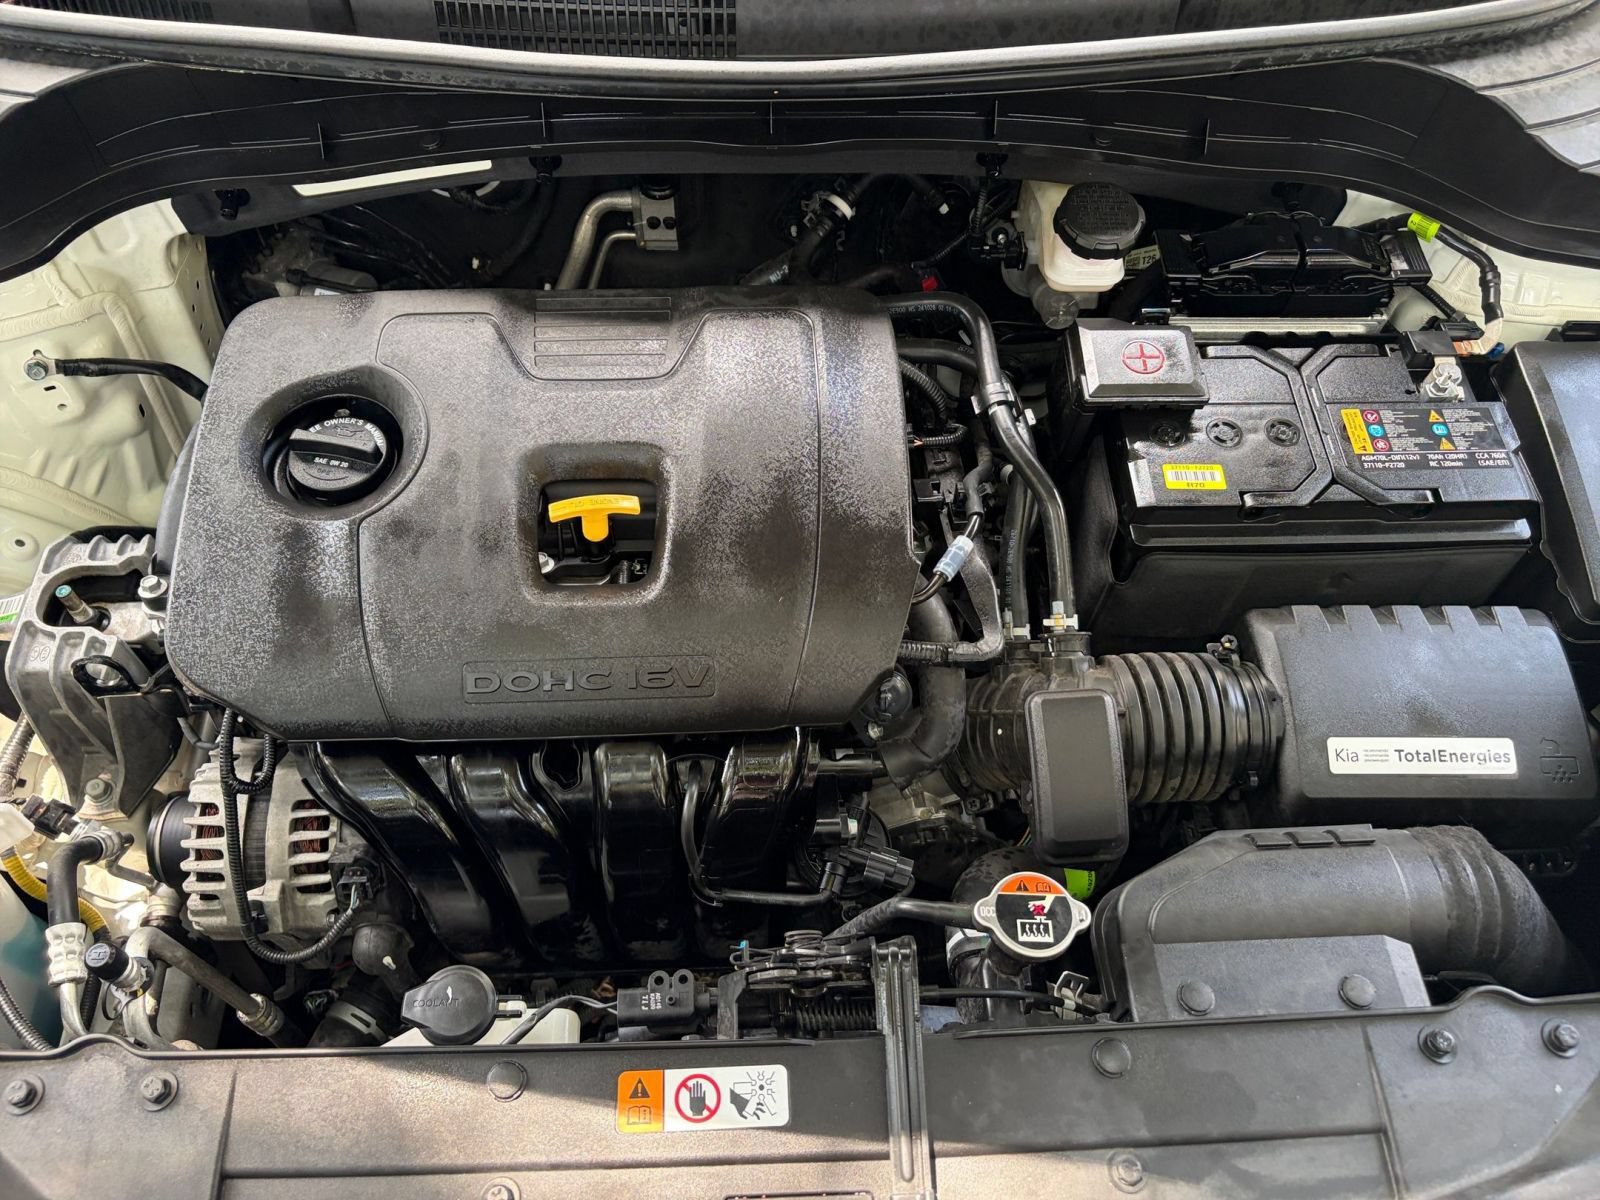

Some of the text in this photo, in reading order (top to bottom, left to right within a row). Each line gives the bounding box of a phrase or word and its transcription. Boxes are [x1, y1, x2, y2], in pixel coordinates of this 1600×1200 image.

[308, 424, 322, 434] EE
[323, 417, 364, 427] OWNER'S
[314, 457, 328, 465] SAE
[465, 665, 711, 694] DOHC 16V
[1335, 748, 1511, 765] Kia TotalEnergies
